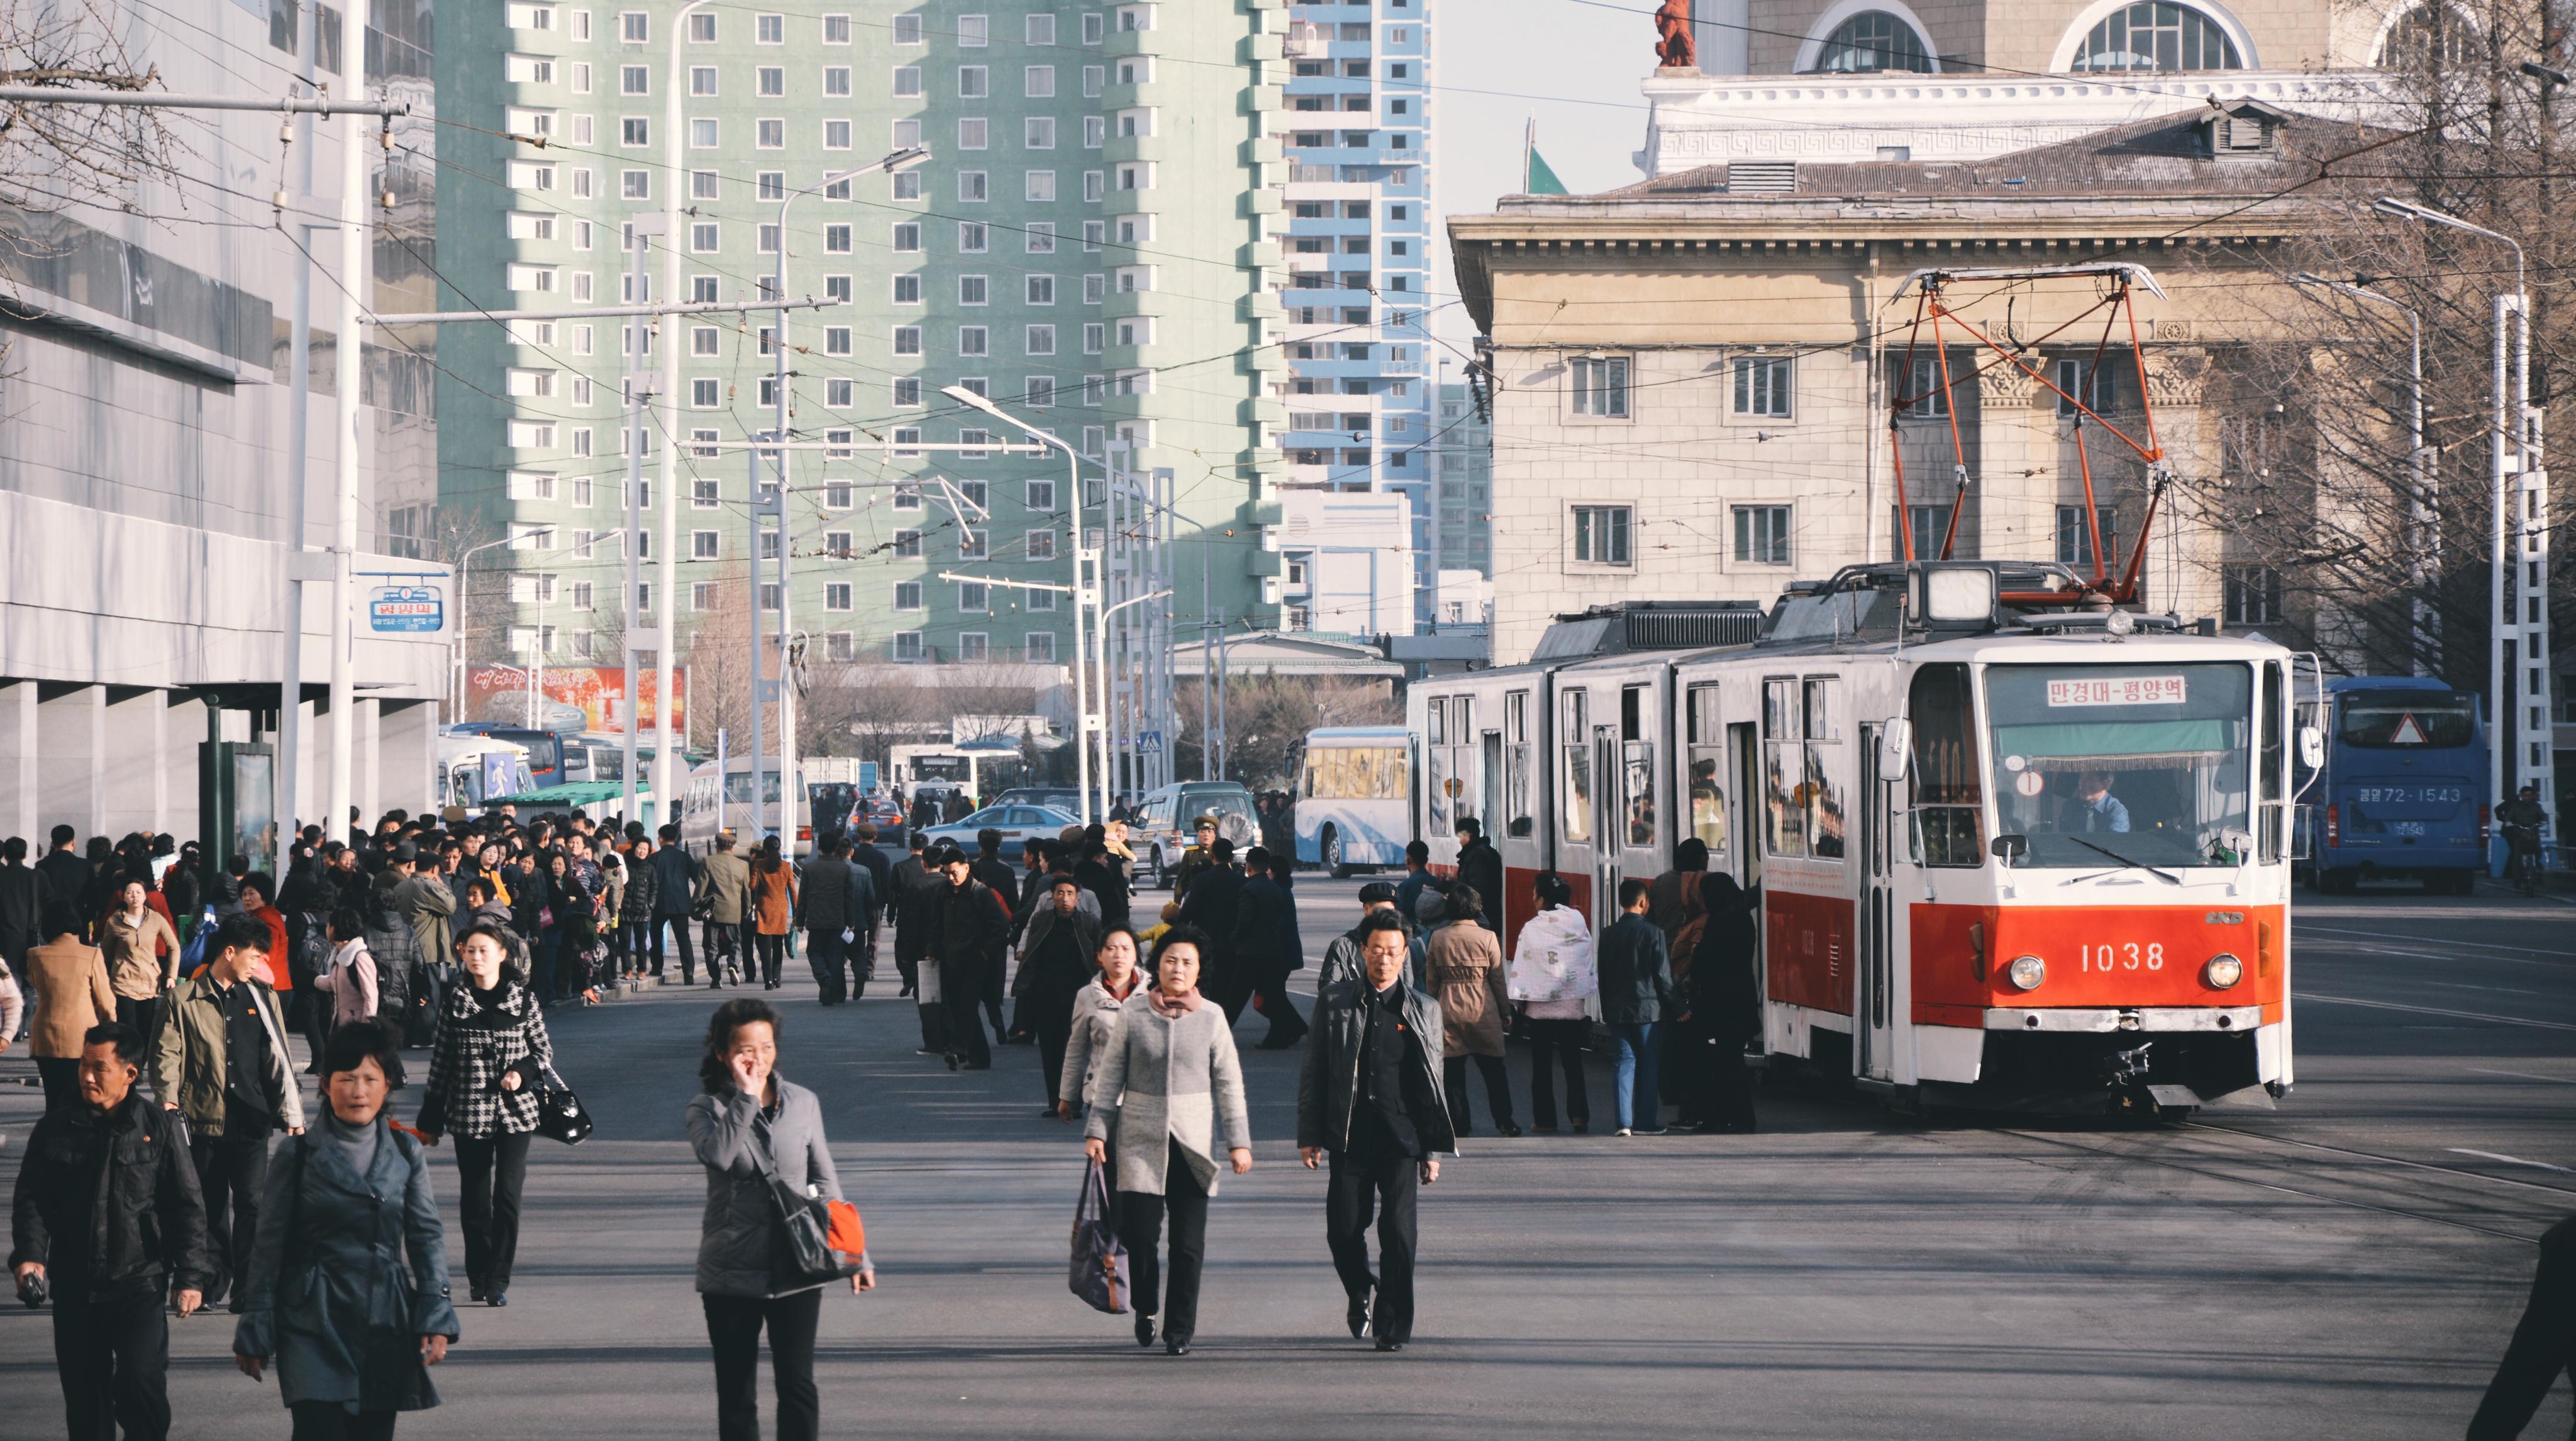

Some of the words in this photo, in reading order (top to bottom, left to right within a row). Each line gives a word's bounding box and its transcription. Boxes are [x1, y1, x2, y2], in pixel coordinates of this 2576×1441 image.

[380, 604, 430, 615] 평양역
[2051, 679, 2182, 703] 만경대-평양역
[2027, 774, 2031, 793] 1
[2082, 943, 2163, 972] 1038
